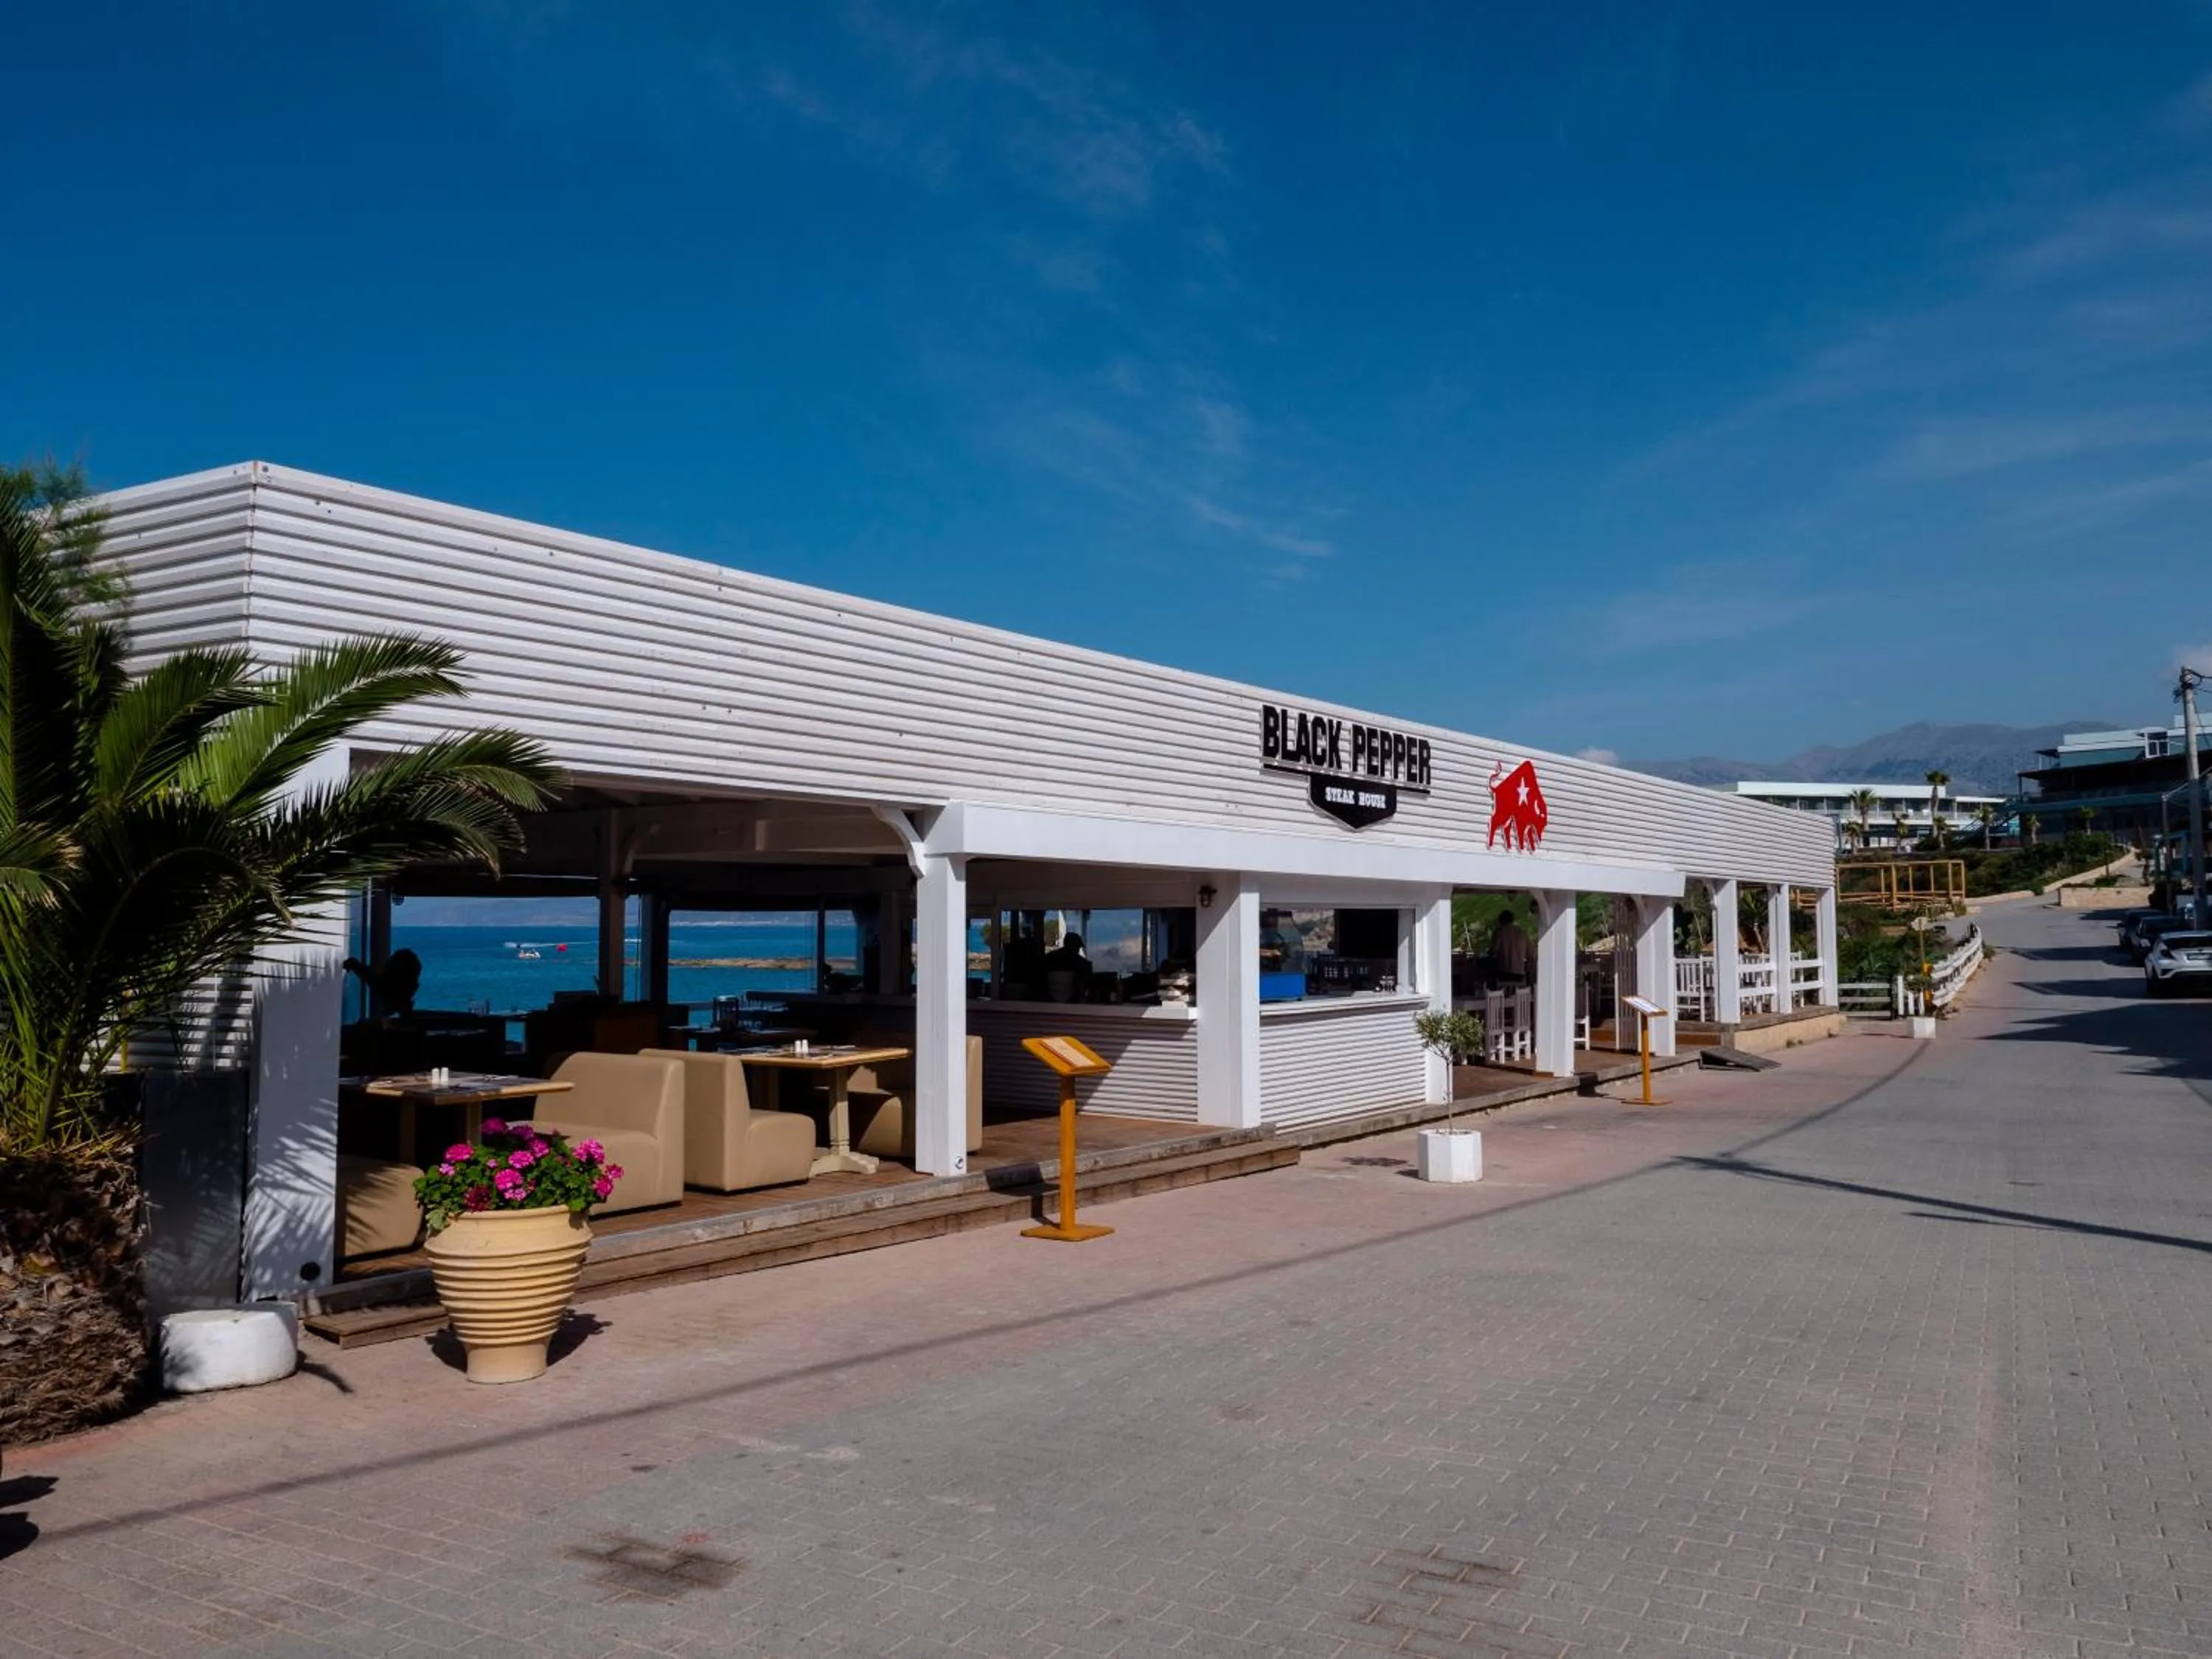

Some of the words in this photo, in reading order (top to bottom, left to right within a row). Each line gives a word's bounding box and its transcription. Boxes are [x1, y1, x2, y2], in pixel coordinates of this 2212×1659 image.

[1262, 705, 1341, 769] BLACK
[1352, 724, 1431, 785] PEPPER
[1325, 787, 1355, 804] STEAK
[1357, 791, 1386, 809] HOUSE
